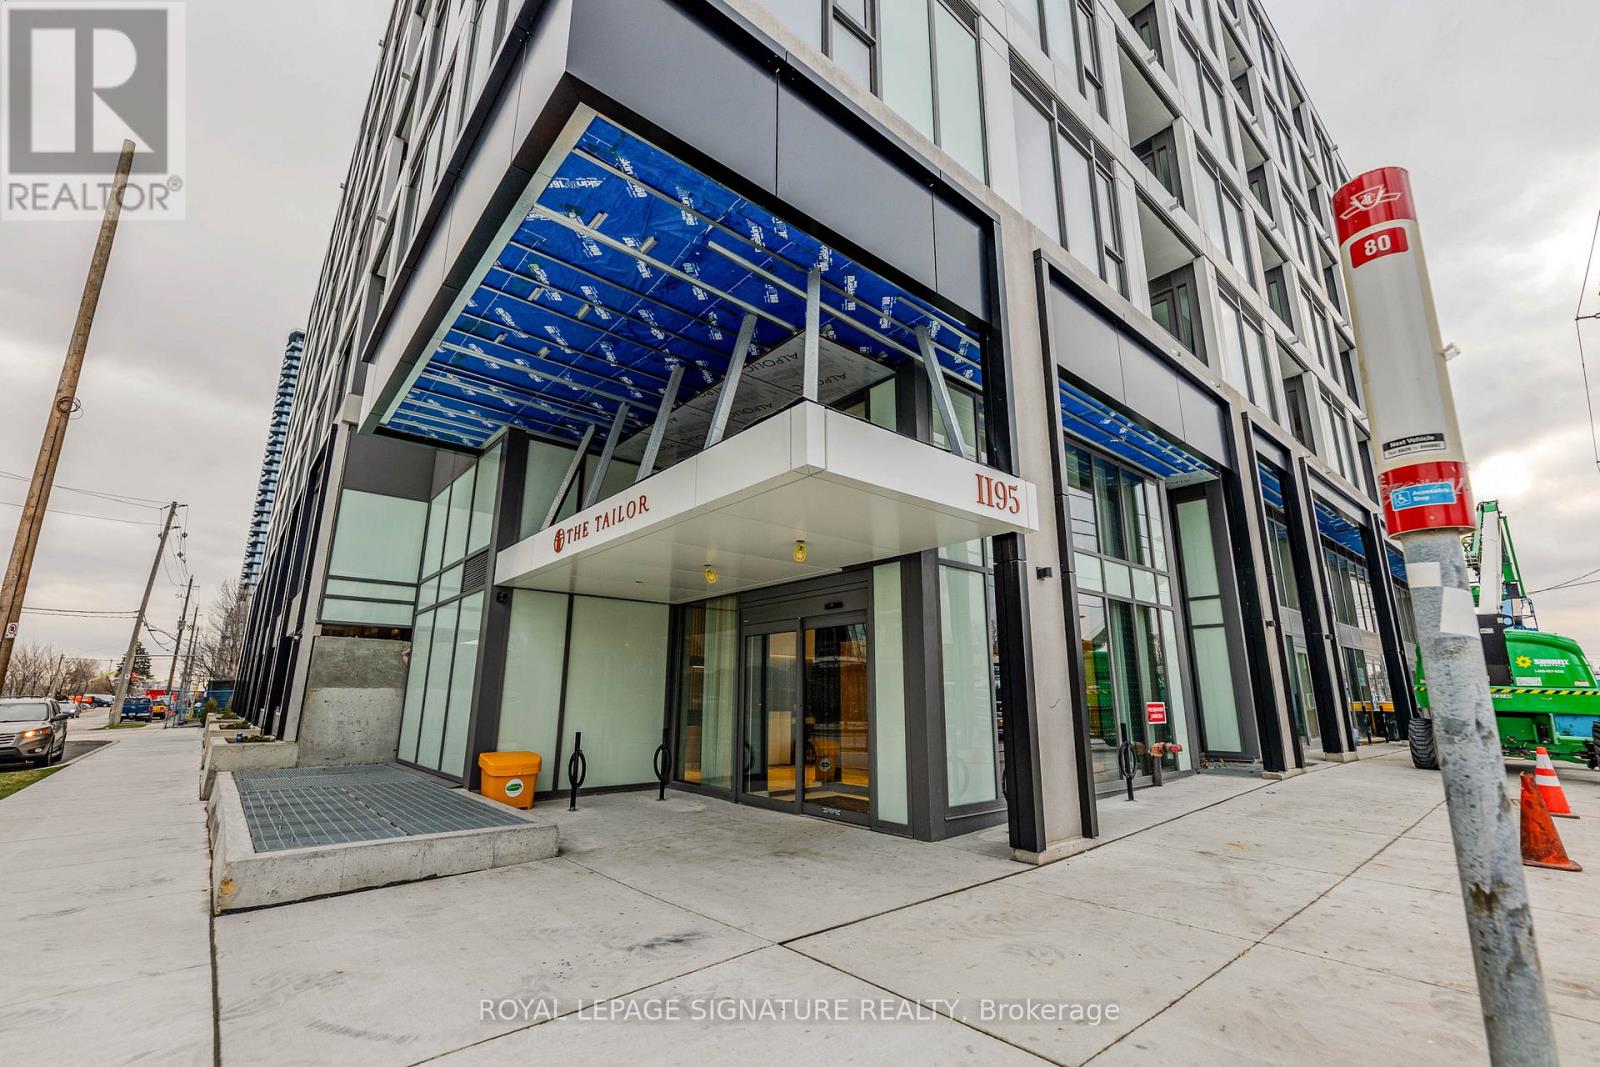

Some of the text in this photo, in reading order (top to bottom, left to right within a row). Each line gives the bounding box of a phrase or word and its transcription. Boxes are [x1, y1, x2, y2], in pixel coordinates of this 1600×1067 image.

[1364, 235, 1391, 256] 80
[747, 352, 799, 374] ALPOLIC
[1390, 435, 1435, 448] Next Vehicle
[975, 473, 1021, 514] 1195
[566, 495, 650, 544] THE TAILOR
